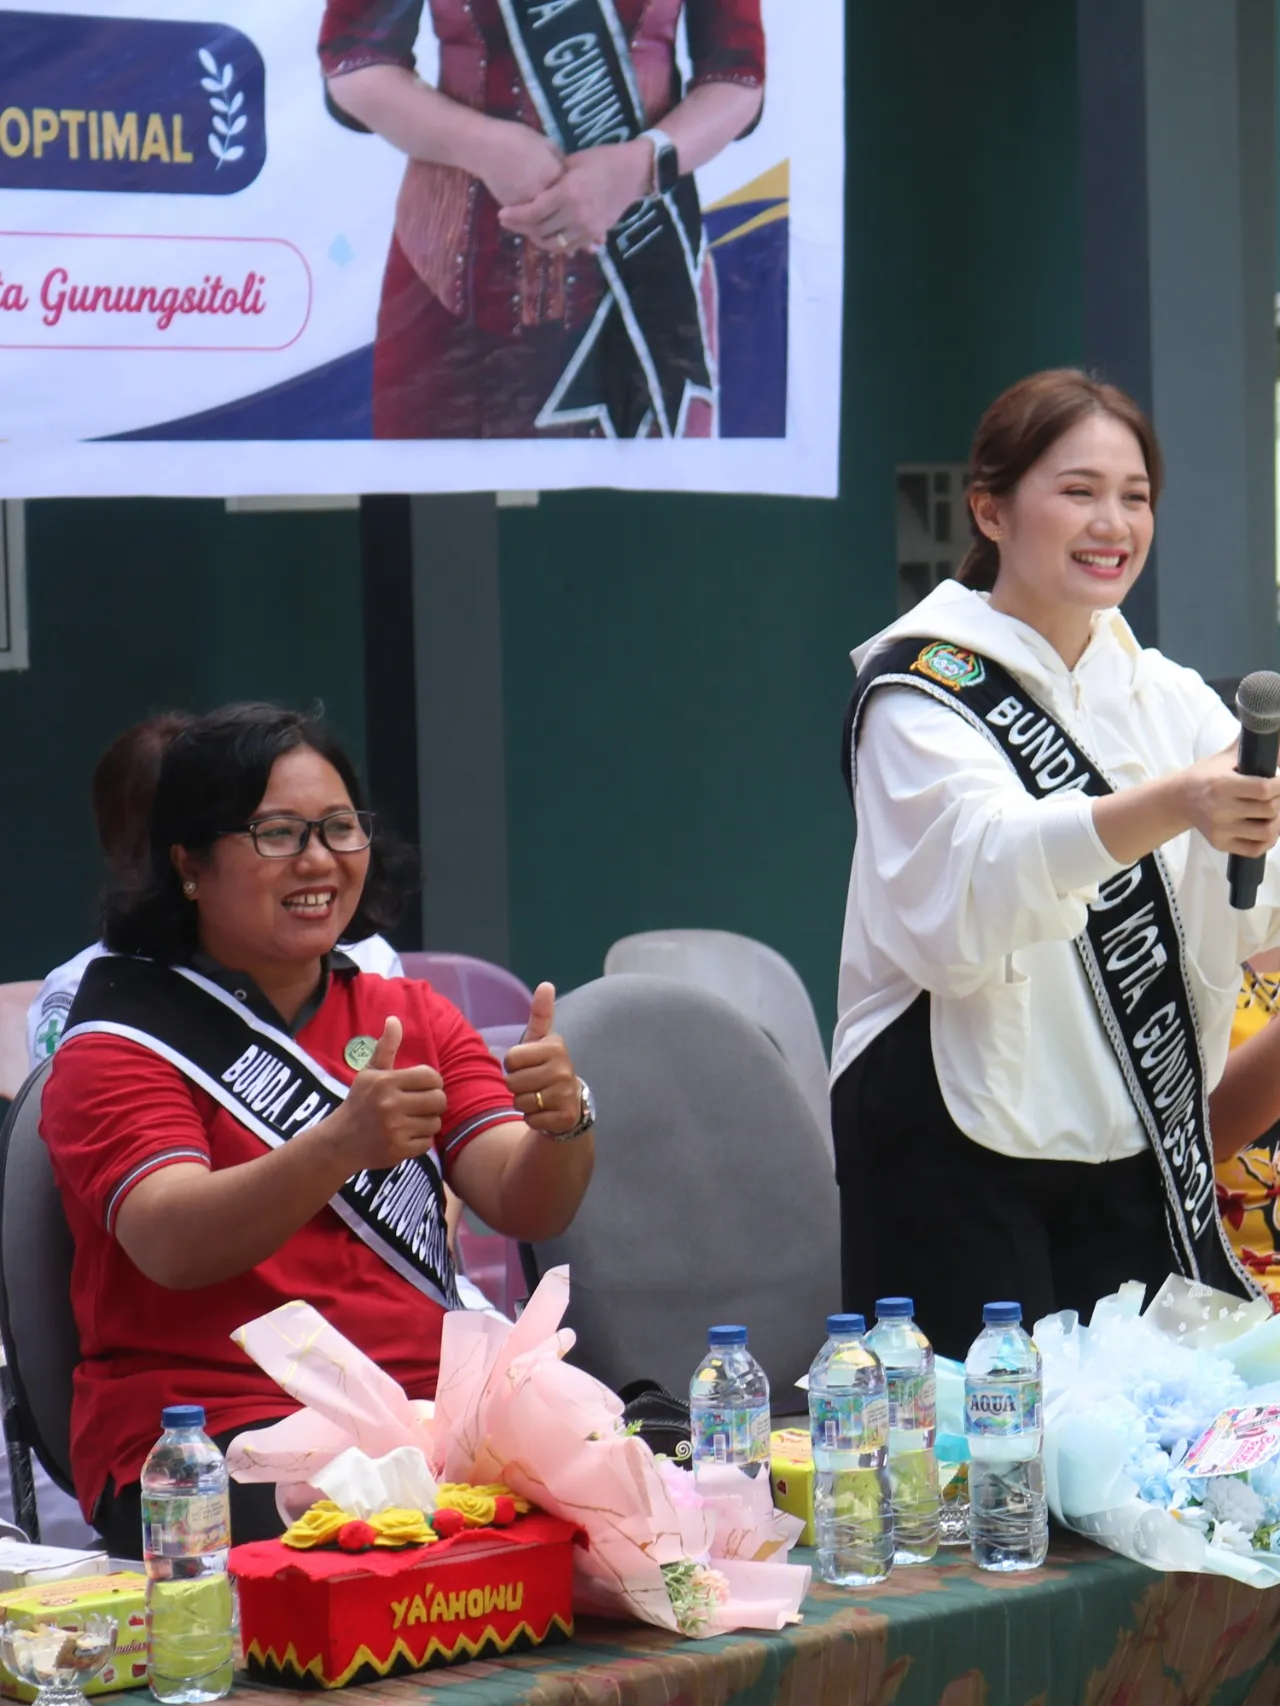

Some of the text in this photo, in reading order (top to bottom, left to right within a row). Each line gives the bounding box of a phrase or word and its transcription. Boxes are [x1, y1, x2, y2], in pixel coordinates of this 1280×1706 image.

[0, 106, 194, 164] OPTIMAL
[40, 266, 267, 331] Gunungsitoli
[1101, 901, 1168, 1015] KOTA
[221, 1044, 302, 1123] BUNDA
[1133, 1001, 1214, 1241] GUNUNGSITOLI
[970, 1394, 1016, 1416] AQUA
